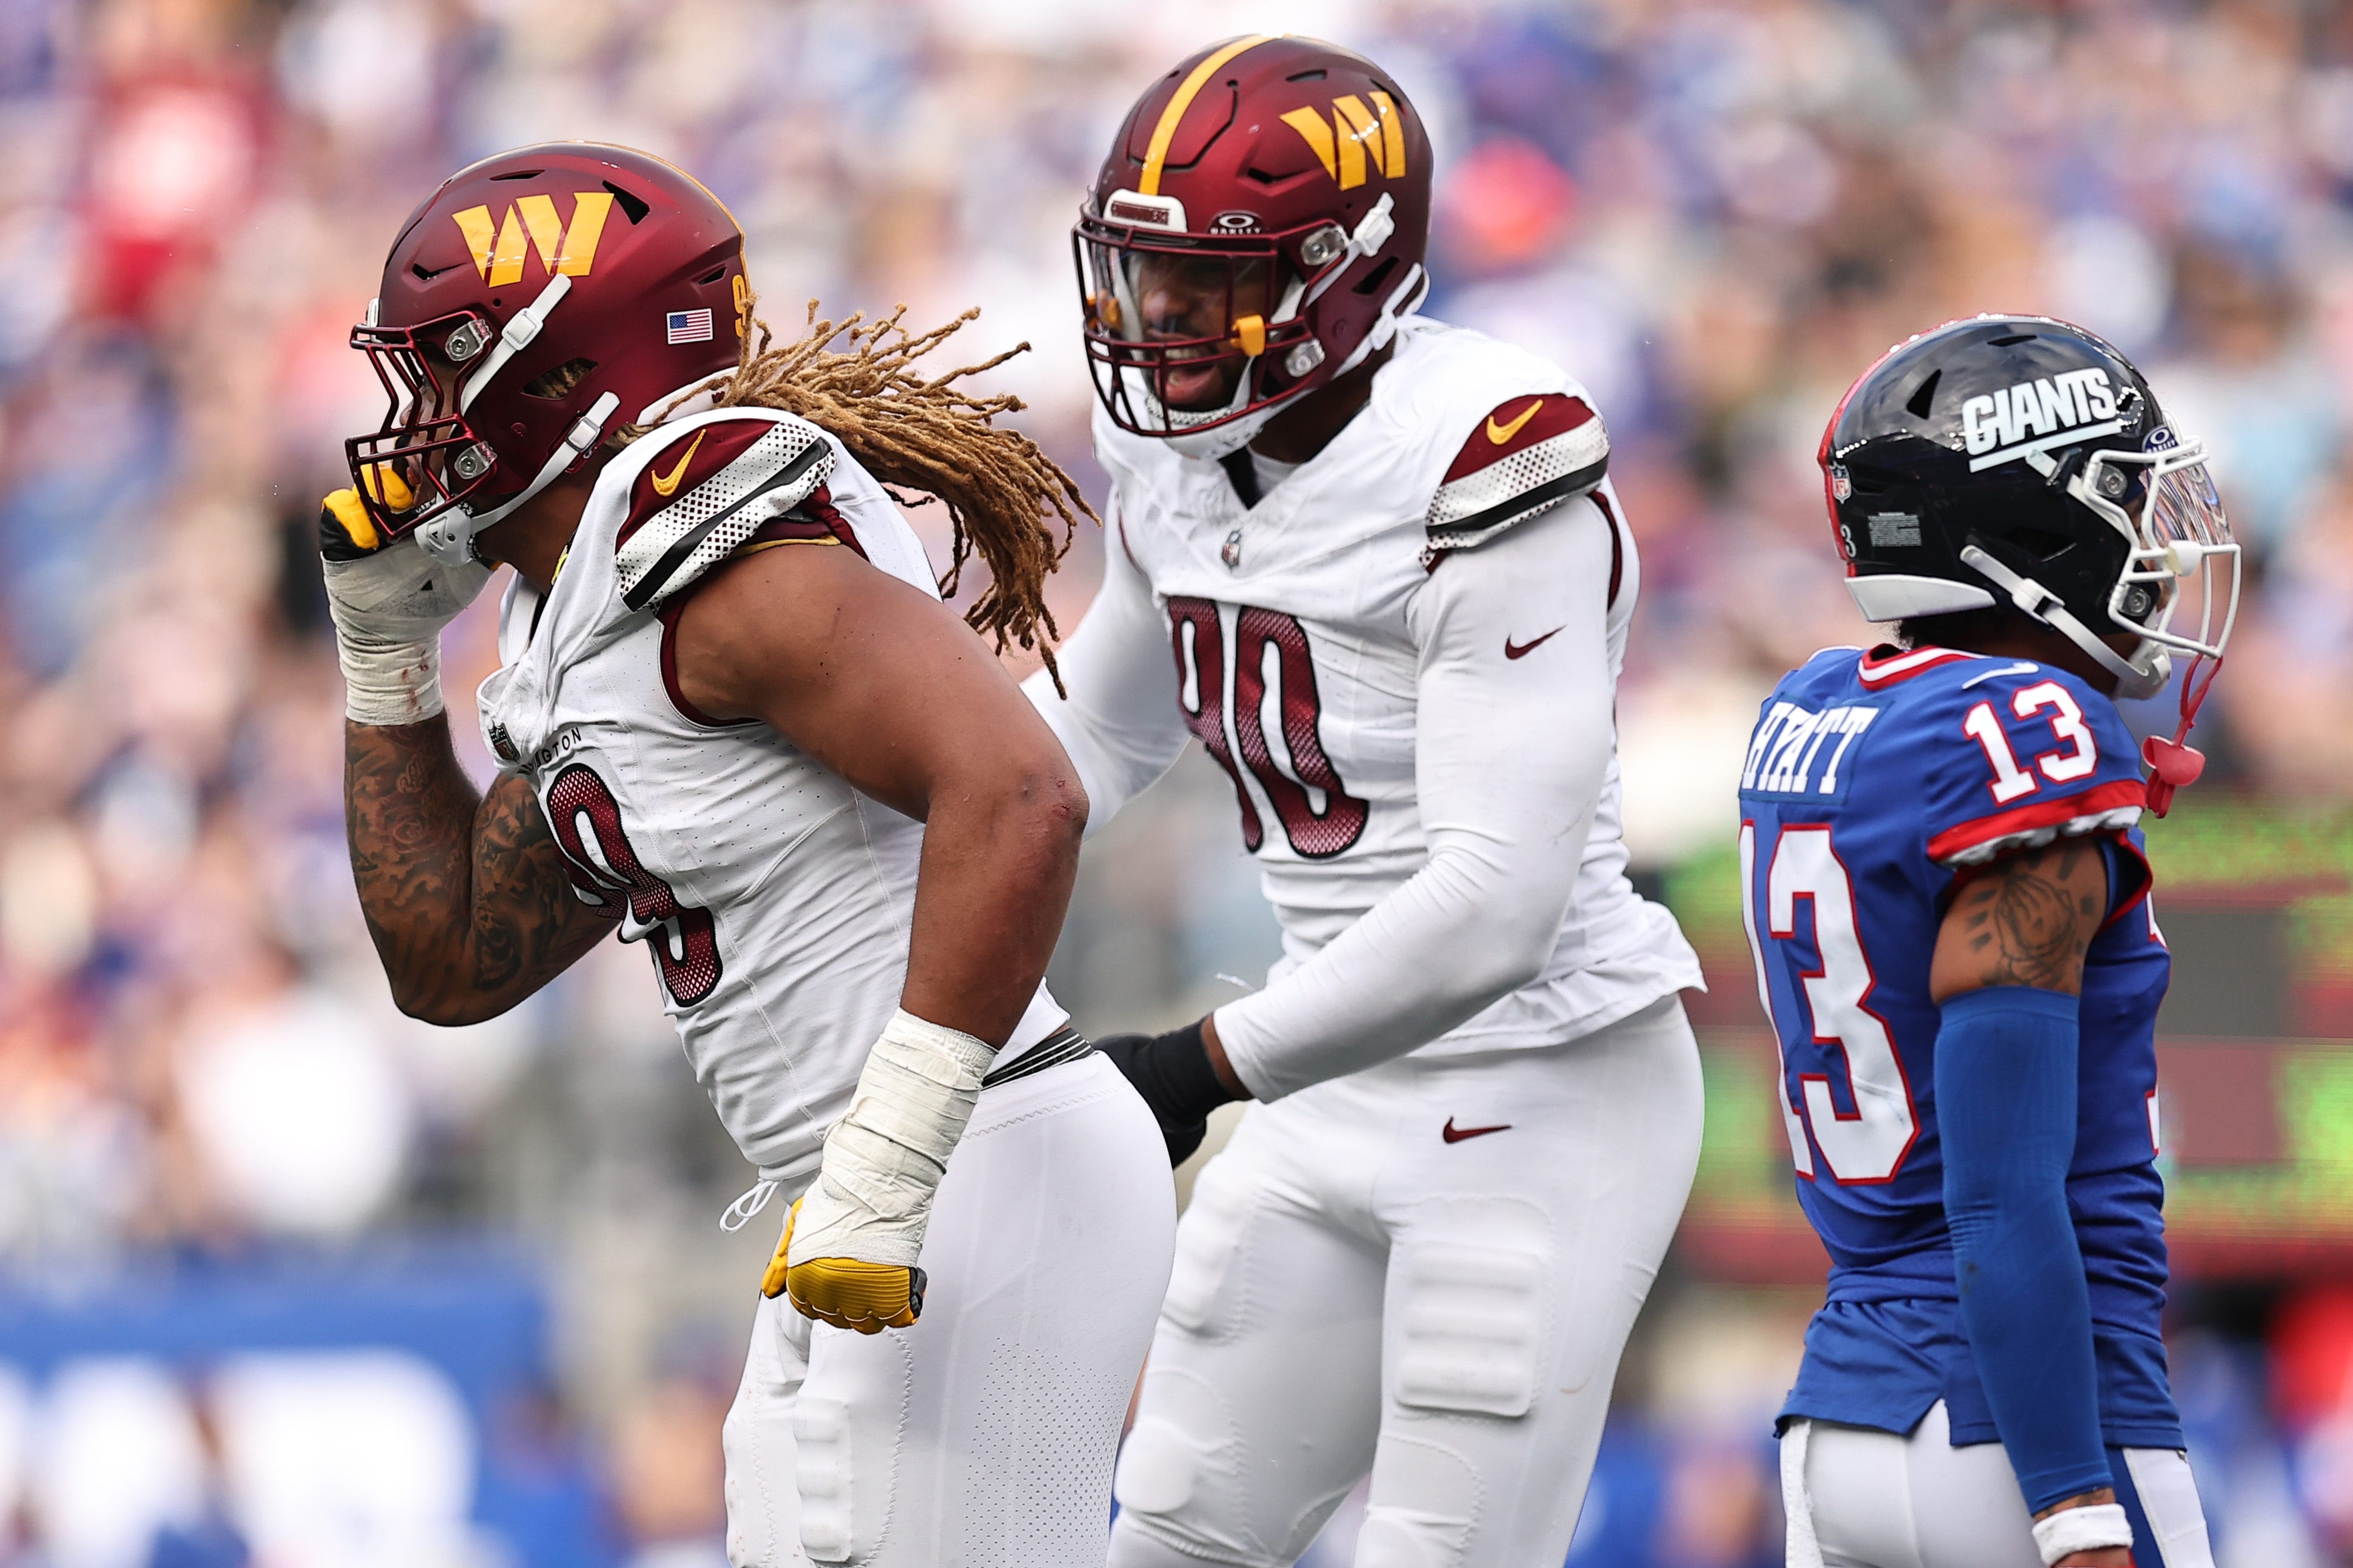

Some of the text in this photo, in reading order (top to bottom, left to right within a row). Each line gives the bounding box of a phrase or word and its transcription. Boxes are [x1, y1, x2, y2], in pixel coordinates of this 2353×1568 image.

[1279, 91, 1406, 191] W
[452, 192, 614, 288] W
[1961, 367, 2117, 455] GIANTS
[1741, 701, 1880, 794] HYATT
[1962, 679, 2099, 807] 13
